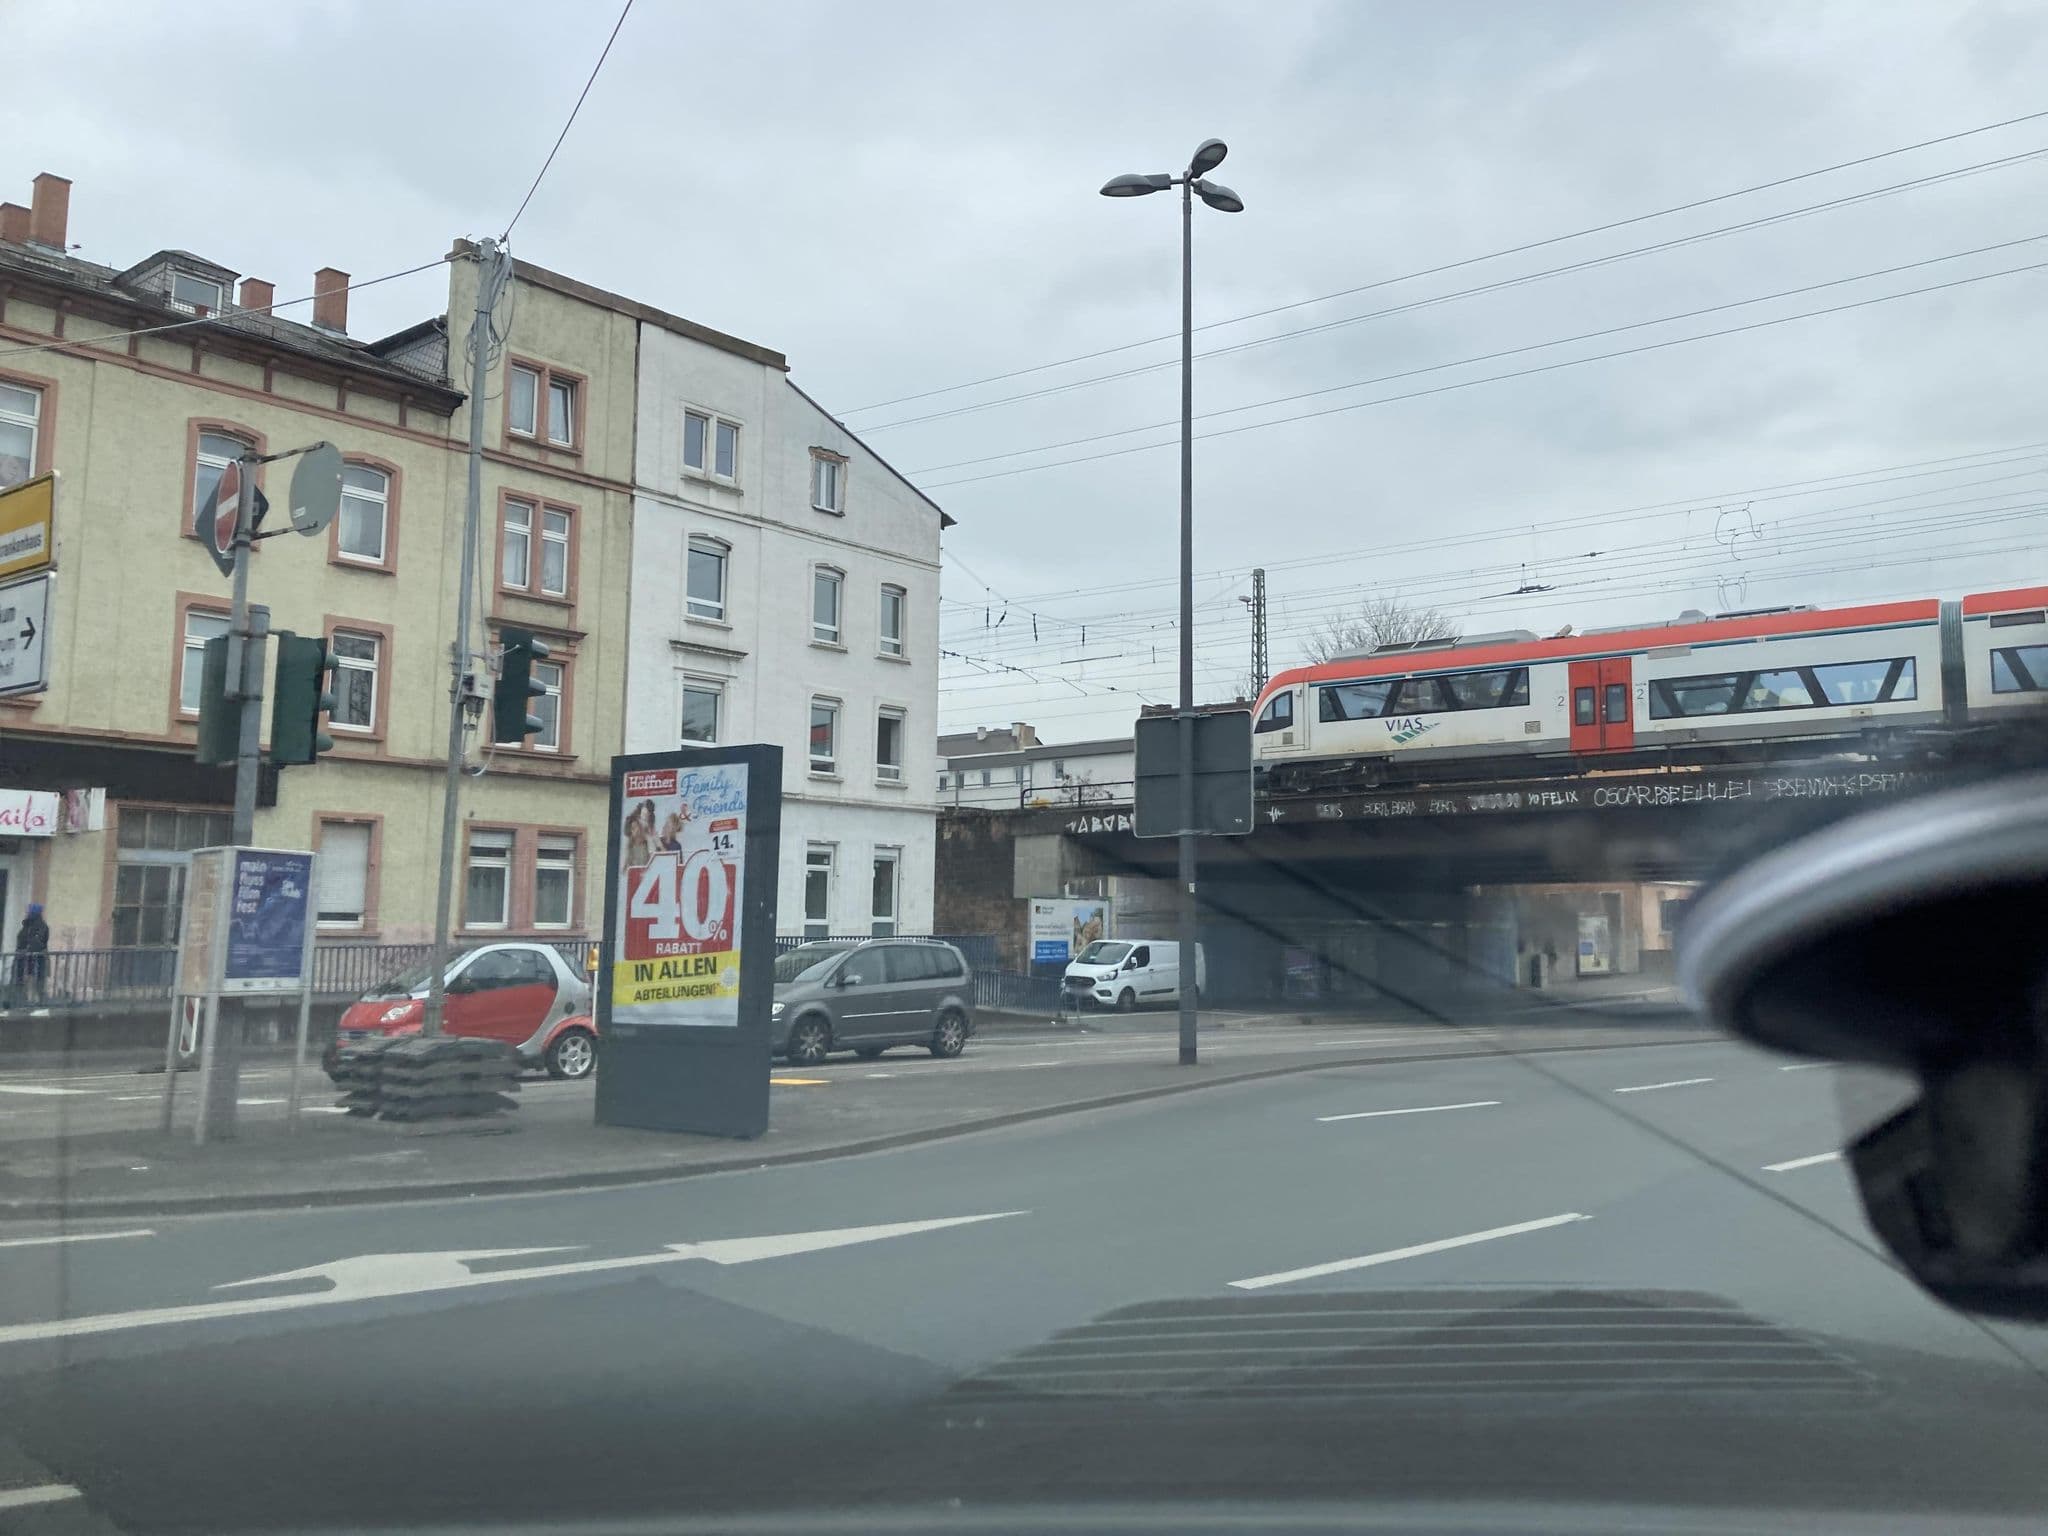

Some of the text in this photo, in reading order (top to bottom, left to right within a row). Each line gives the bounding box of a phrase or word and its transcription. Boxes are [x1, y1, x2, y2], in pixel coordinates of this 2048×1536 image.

[1557, 696, 1565, 707] 2
[1637, 688, 1644, 700] 2
[1386, 717, 1424, 732] VIAS
[680, 770, 731, 799] Family
[692, 790, 745, 820] Friends
[1541, 790, 1579, 806] FELIX
[712, 834, 734, 851] 14.
[655, 942, 703, 955] RABATT
[634, 956, 718, 982] IN ALLEN
